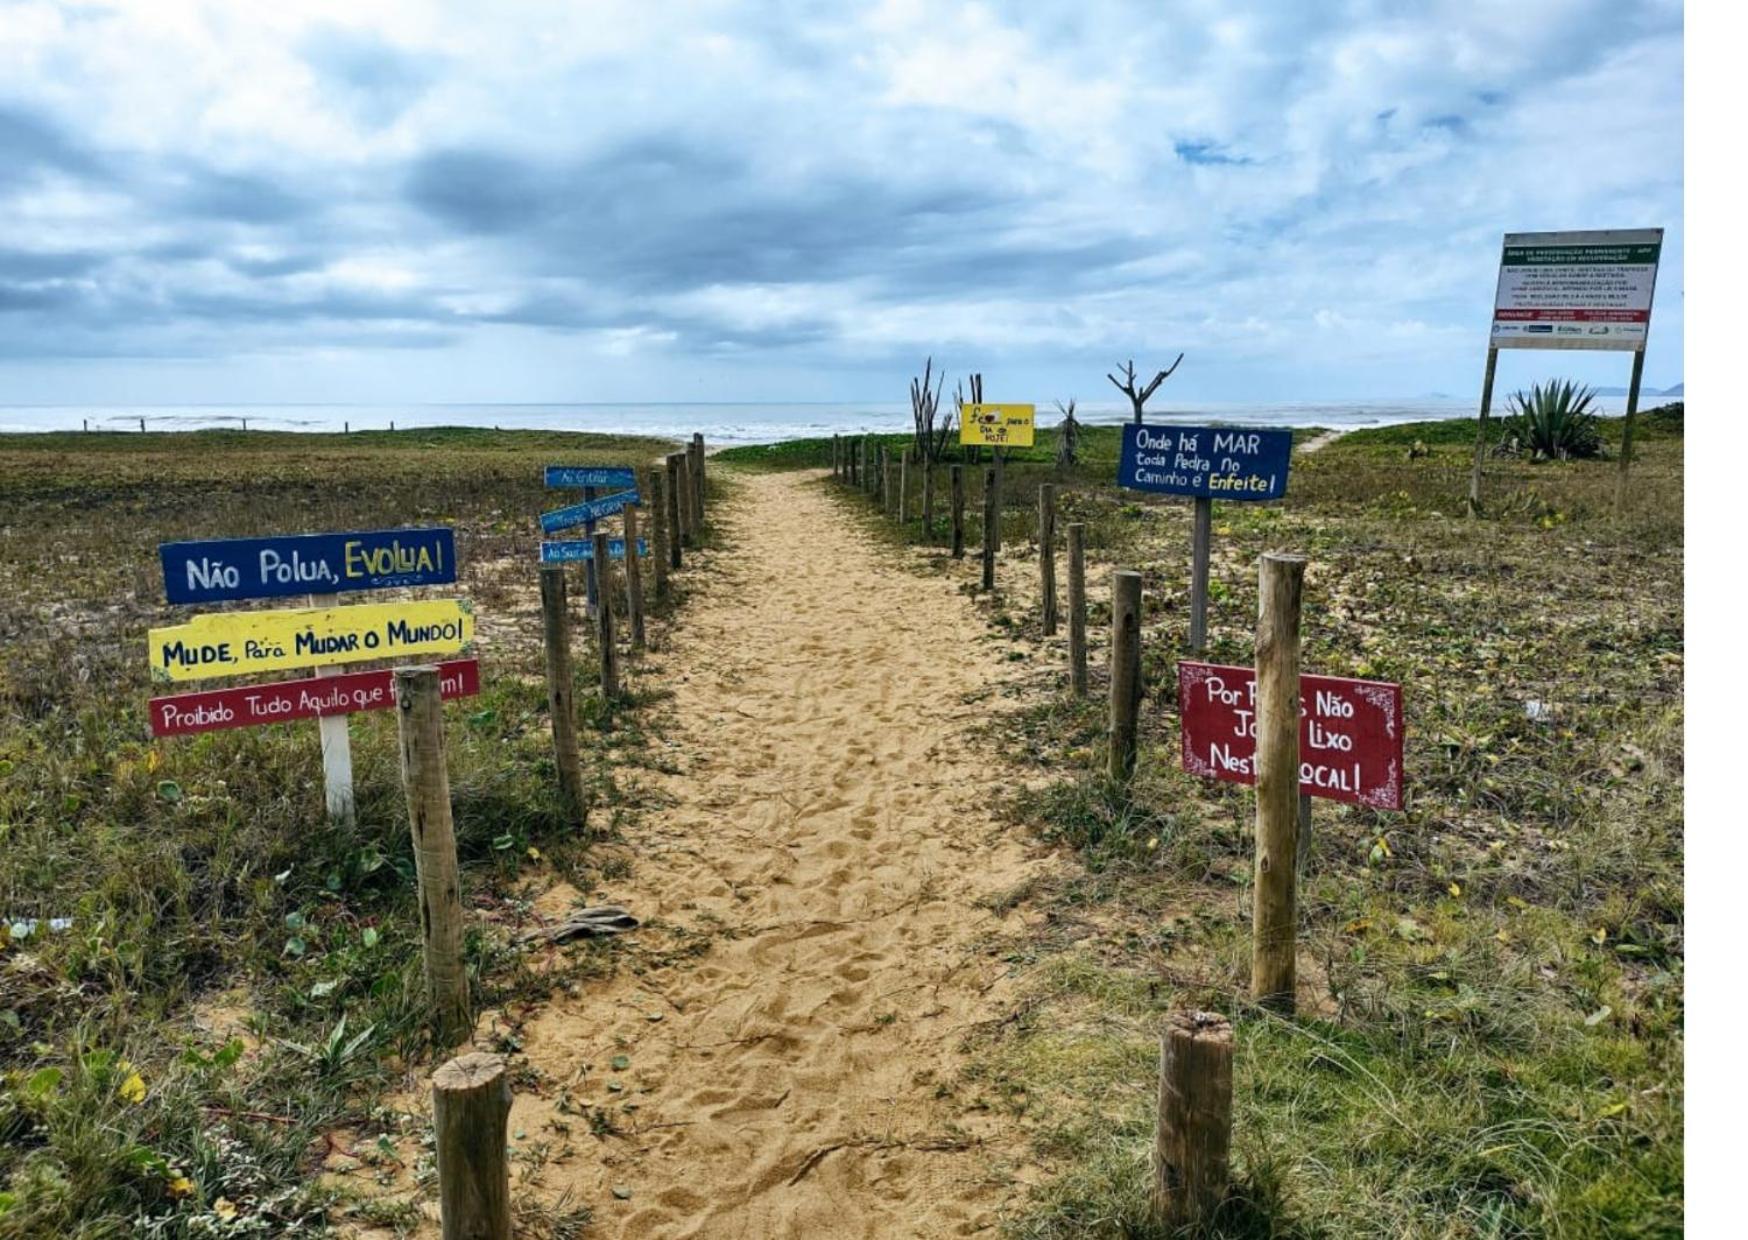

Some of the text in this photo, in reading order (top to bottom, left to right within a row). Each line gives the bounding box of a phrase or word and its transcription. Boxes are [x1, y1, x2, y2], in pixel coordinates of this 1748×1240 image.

[1136, 429, 1261, 454] Onde há MAR
[1136, 453, 1166, 467] toda
[1174, 453, 1210, 472] Pedra
[1135, 468, 1188, 486] Caminho
[1208, 472, 1276, 493] Enfeite!
[296, 631, 359, 656] MUDAR
[387, 619, 462, 647] MUNDO!
[161, 704, 234, 729] Proibido
[246, 696, 292, 717] Tudo
[300, 686, 349, 714] Aquilo
[353, 687, 383, 710] que
[1205, 676, 1242, 707] Por
[1316, 690, 1353, 718] Não
[1309, 720, 1352, 751] Lixo
[1299, 763, 1360, 796] OCAL!
